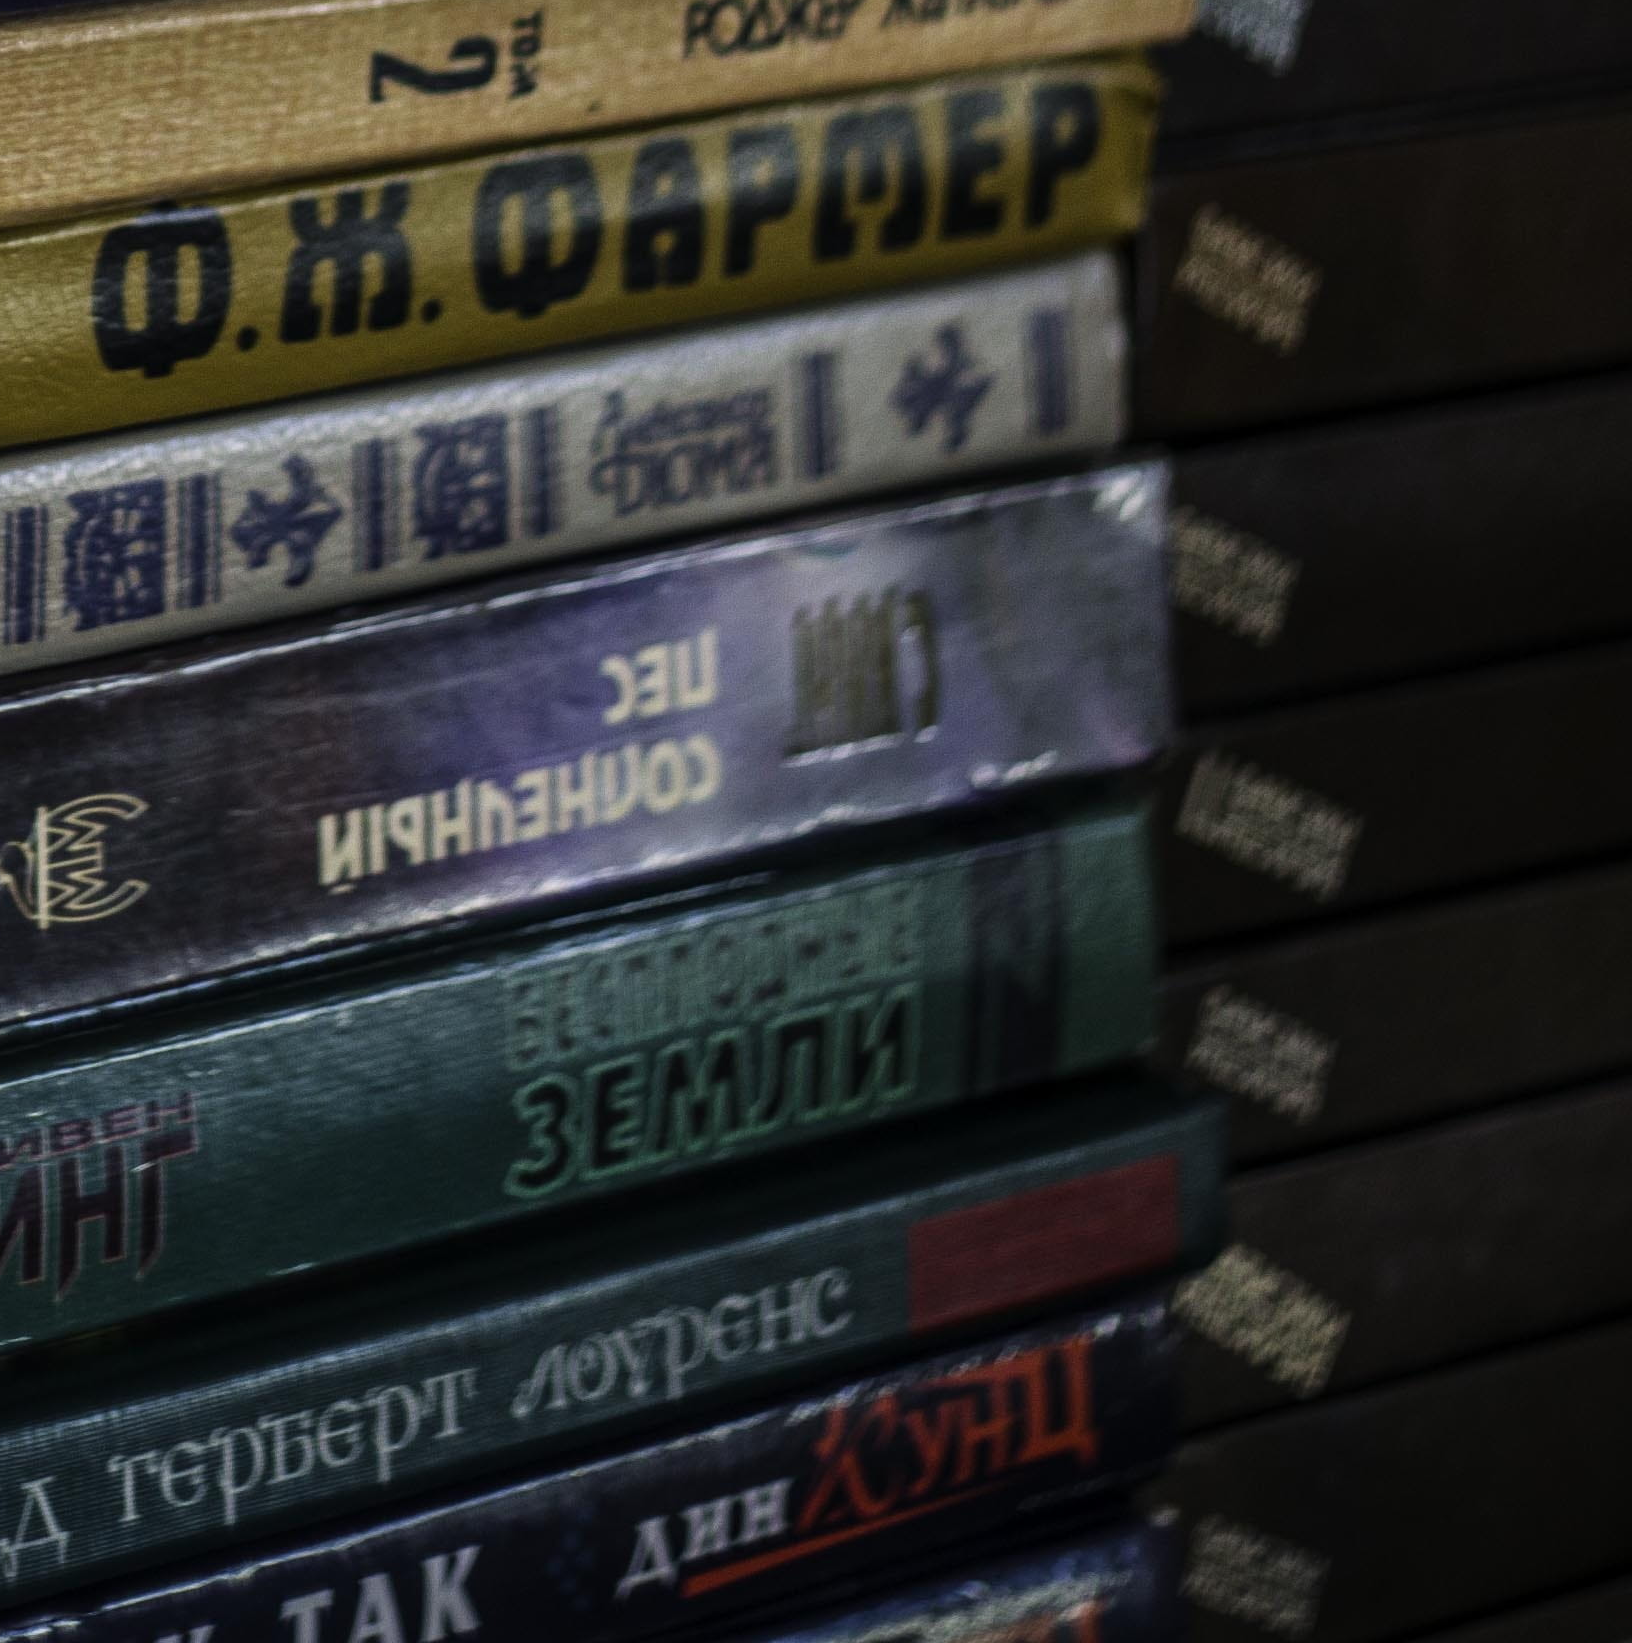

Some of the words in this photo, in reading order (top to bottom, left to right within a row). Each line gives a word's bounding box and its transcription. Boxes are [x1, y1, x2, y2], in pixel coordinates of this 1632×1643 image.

[368, 37, 499, 103] 2
[603, 630, 716, 724] ПЕС
[318, 737, 721, 894] СОЛНЕЧНЫЙ
[505, 981, 922, 1199] ЗЕМЛИ
